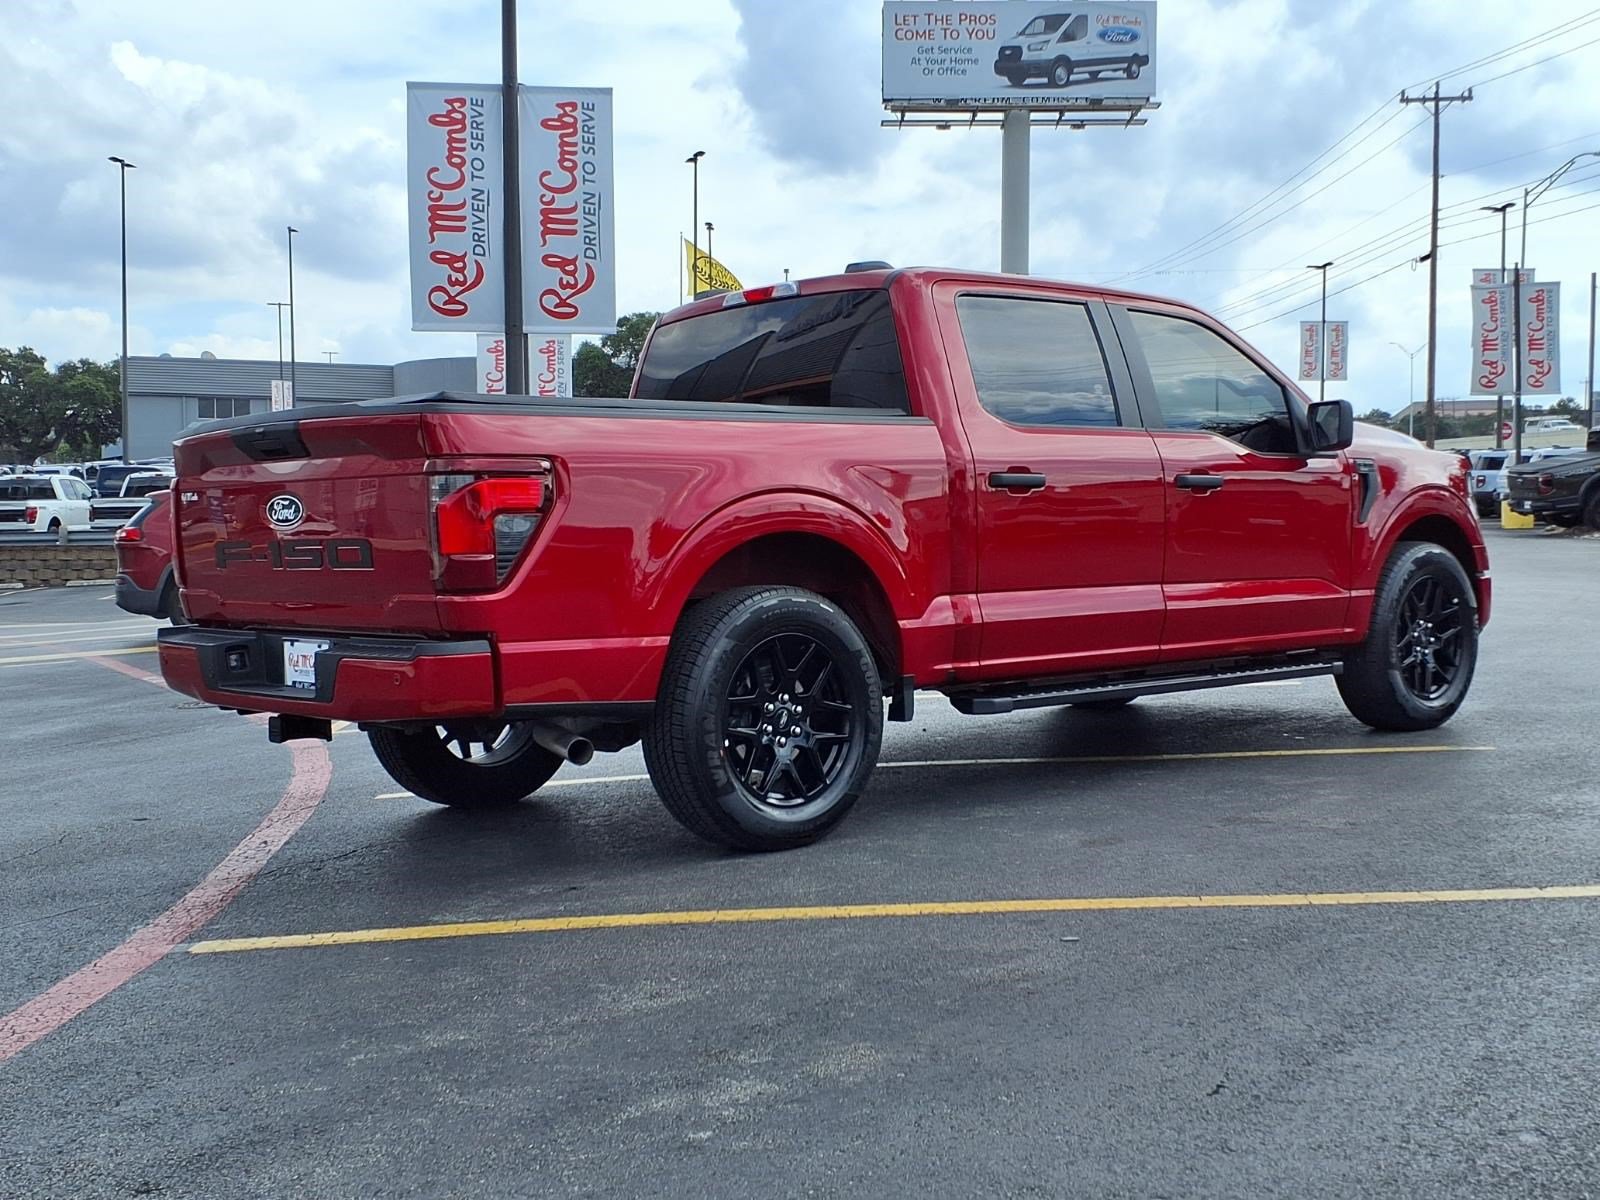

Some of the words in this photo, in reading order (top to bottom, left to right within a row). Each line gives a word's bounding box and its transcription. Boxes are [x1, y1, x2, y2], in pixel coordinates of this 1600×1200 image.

[894, 13, 919, 26] LET
[924, 12, 953, 26] THE
[958, 12, 997, 26] PROS
[894, 28, 935, 41] COME
[940, 27, 960, 41] TO
[965, 27, 996, 41] YOU
[1104, 30, 1133, 42] Ford
[910, 57, 922, 66] At
[924, 57, 946, 66] Your
[949, 57, 980, 66] Home
[917, 45, 935, 55] Get
[937, 45, 973, 55] Service
[922, 66, 935, 76] Or
[937, 66, 968, 76] Office
[469, 96, 485, 152] SERVE
[581, 101, 596, 155] SERVE
[426, 96, 468, 245] McCombs
[470, 158, 486, 182] TO
[538, 101, 579, 248] McCombs
[582, 160, 597, 184] TO
[471, 188, 487, 257] DRIVEN
[582, 191, 598, 261] DRIVEN
[427, 250, 486, 318] Red
[538, 254, 596, 320] Red
[1527, 288, 1545, 357] McCombs
[557, 339, 565, 366] SERVE
[557, 367, 565, 379] TO
[1478, 359, 1505, 389] Red
[1526, 359, 1552, 388] Red
[271, 499, 296, 520] Ford
[214, 538, 376, 571] F-150
